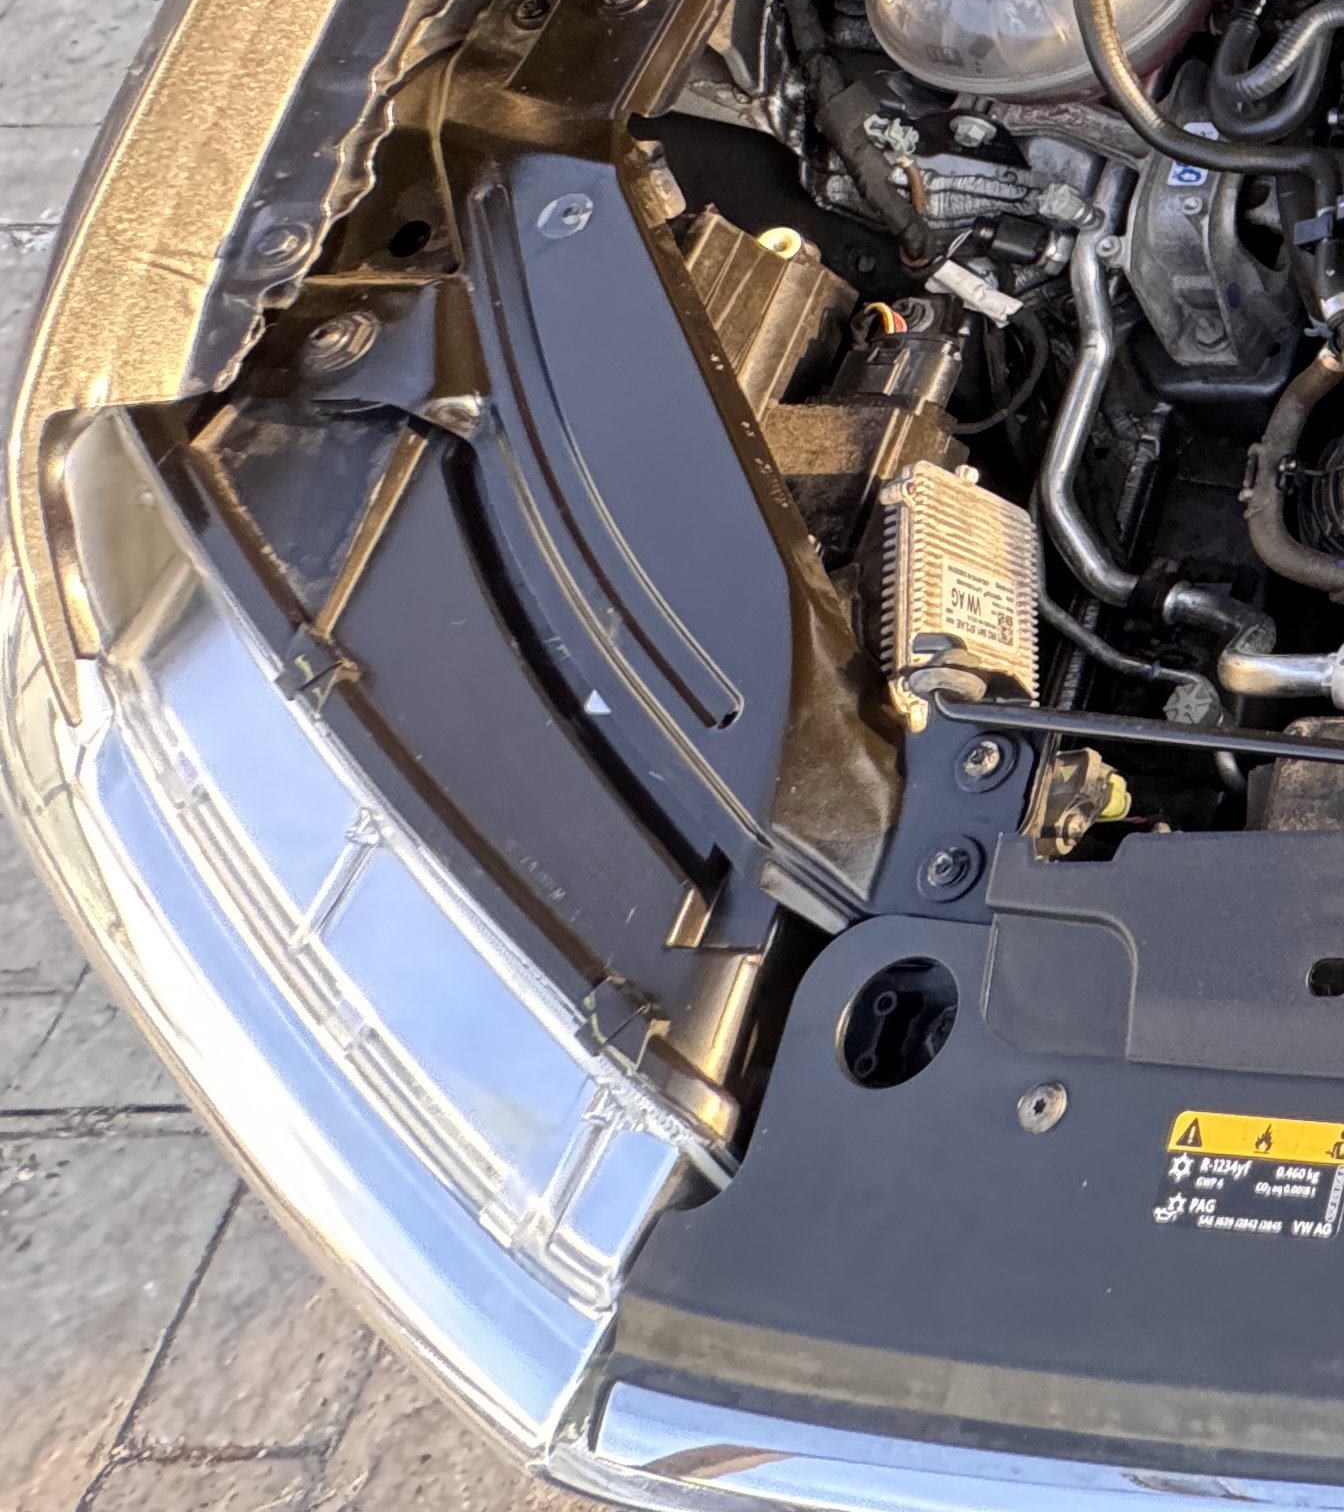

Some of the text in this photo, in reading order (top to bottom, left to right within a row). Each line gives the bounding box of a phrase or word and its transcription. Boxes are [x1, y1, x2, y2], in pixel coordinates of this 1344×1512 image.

[951, 587, 966, 609] AG
[967, 592, 982, 617] VW
[1200, 1157, 1252, 1180] R-1234yf
[1275, 1165, 1322, 1185] 0.460 kg
[1188, 1198, 1218, 1215] PAG
[1291, 1219, 1334, 1238] VW AG
